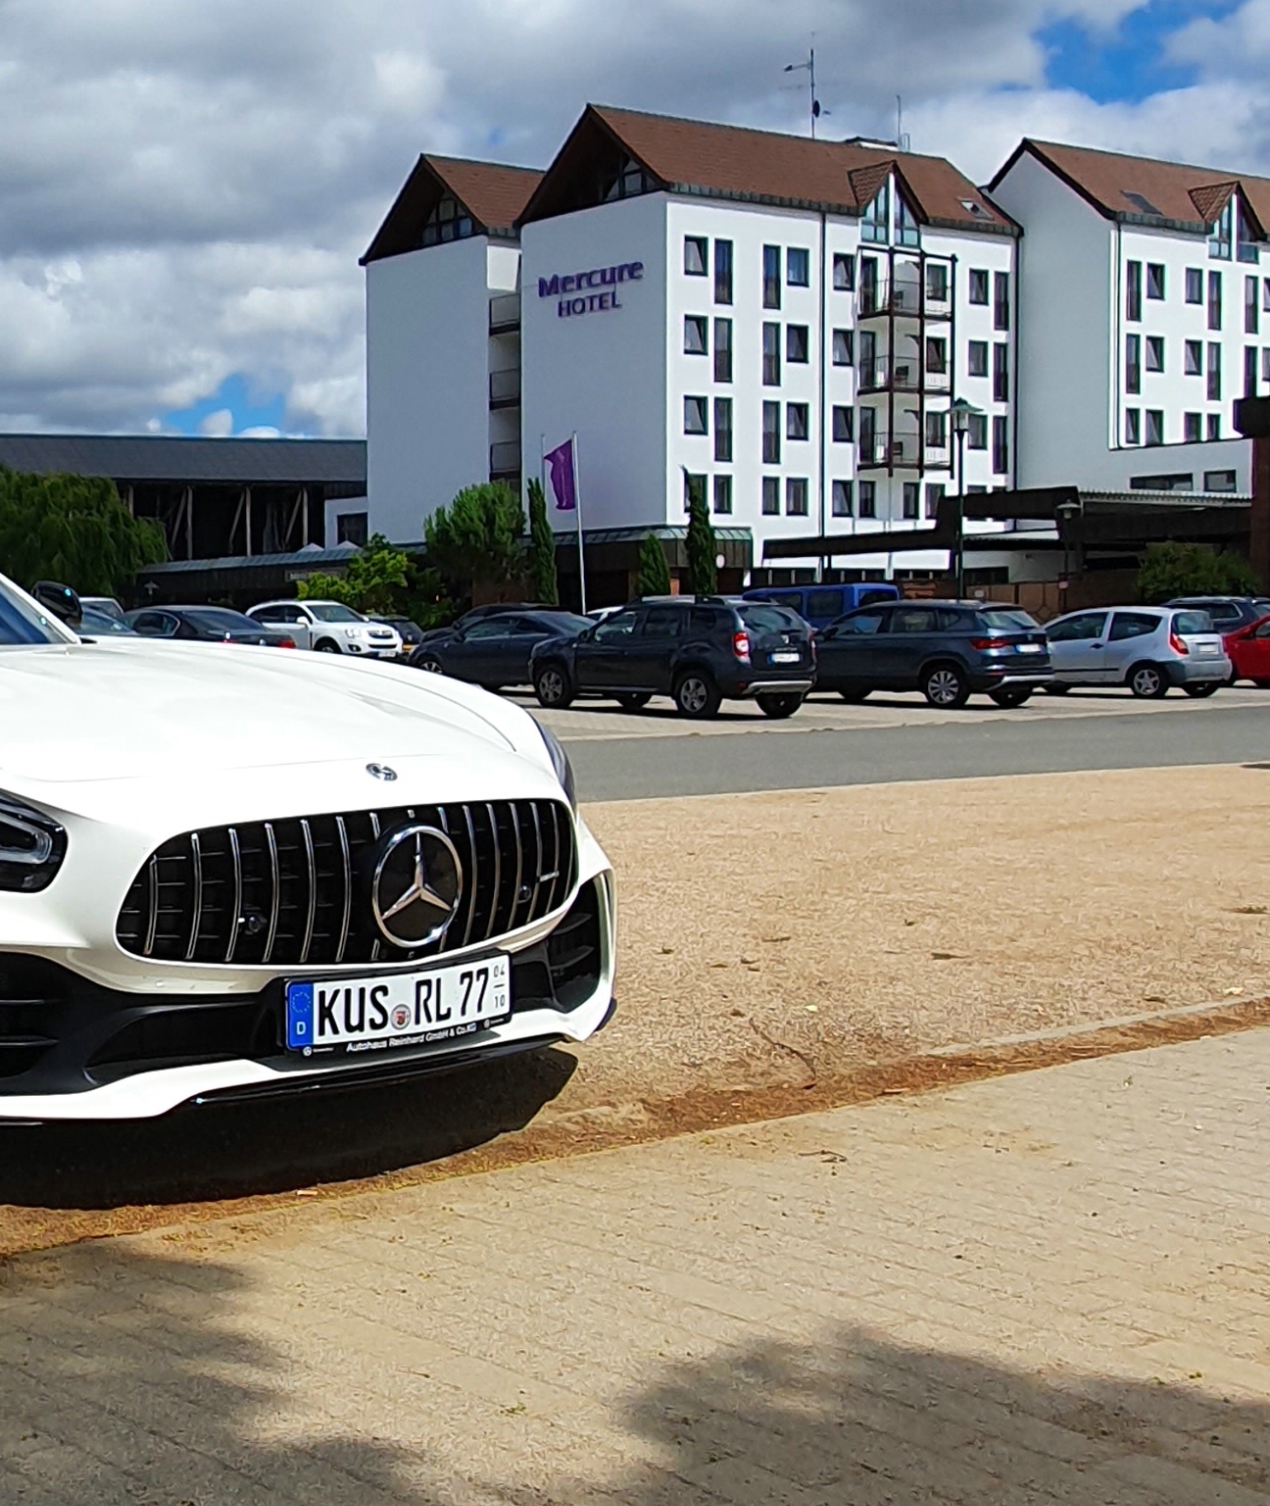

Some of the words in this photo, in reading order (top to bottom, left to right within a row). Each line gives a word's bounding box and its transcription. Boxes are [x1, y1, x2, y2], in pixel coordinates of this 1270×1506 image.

[538, 261, 644, 297] Mercure
[557, 291, 622, 317] HOTEL
[296, 1021, 307, 1036] D
[318, 985, 389, 1036] KUS
[415, 977, 451, 1025] RL
[460, 967, 489, 1016] 77
[494, 994, 505, 1008] 10
[346, 1039, 388, 1052] Autohaus
